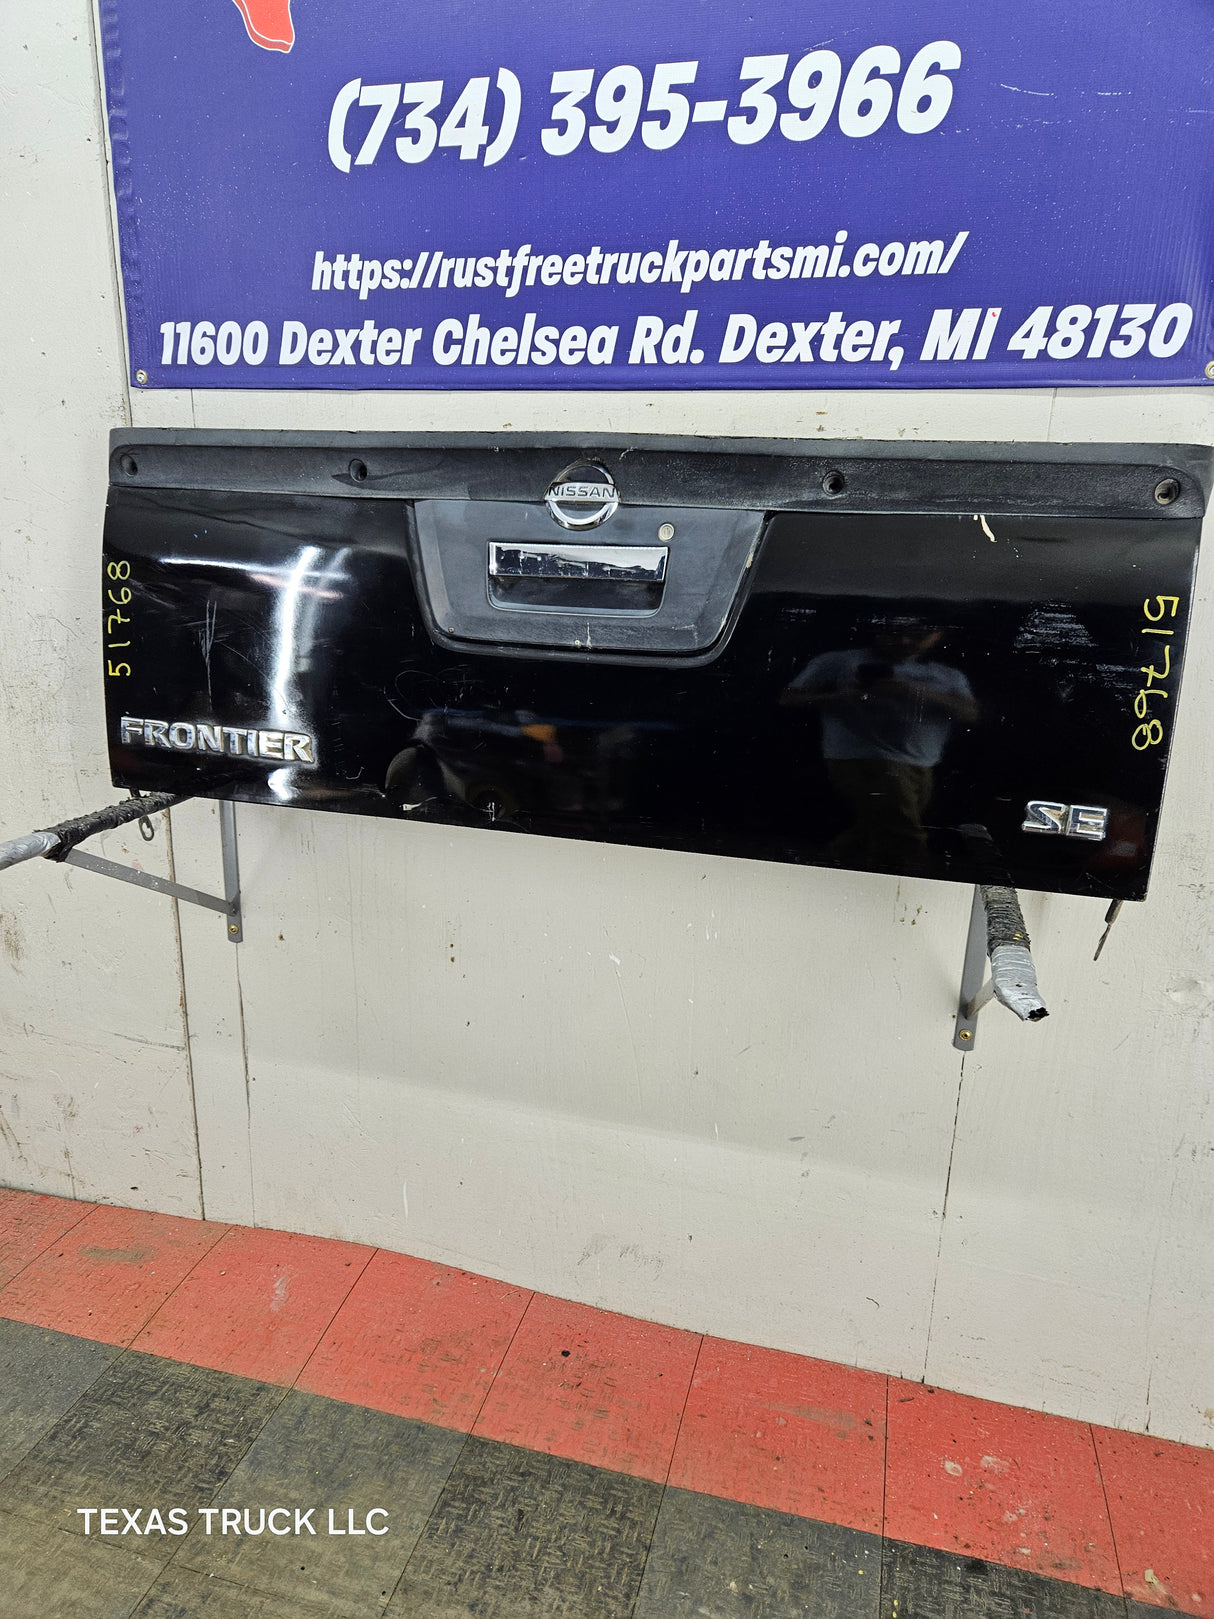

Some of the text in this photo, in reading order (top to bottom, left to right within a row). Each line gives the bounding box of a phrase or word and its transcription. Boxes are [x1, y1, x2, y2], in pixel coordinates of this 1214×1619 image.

[328, 40, 962, 173] (734) 395-3966
[311, 230, 970, 300] https://rustfreetruckpartsmi.com/
[159, 302, 1194, 371] 11600 Dexter Chelsea Rd. Dexter, MI 48130
[549, 485, 616, 498] NISSAN
[108, 559, 132, 678] 51768
[1131, 595, 1180, 751] 51768
[120, 716, 316, 764] FRONTIER
[1021, 800, 1109, 841] SE
